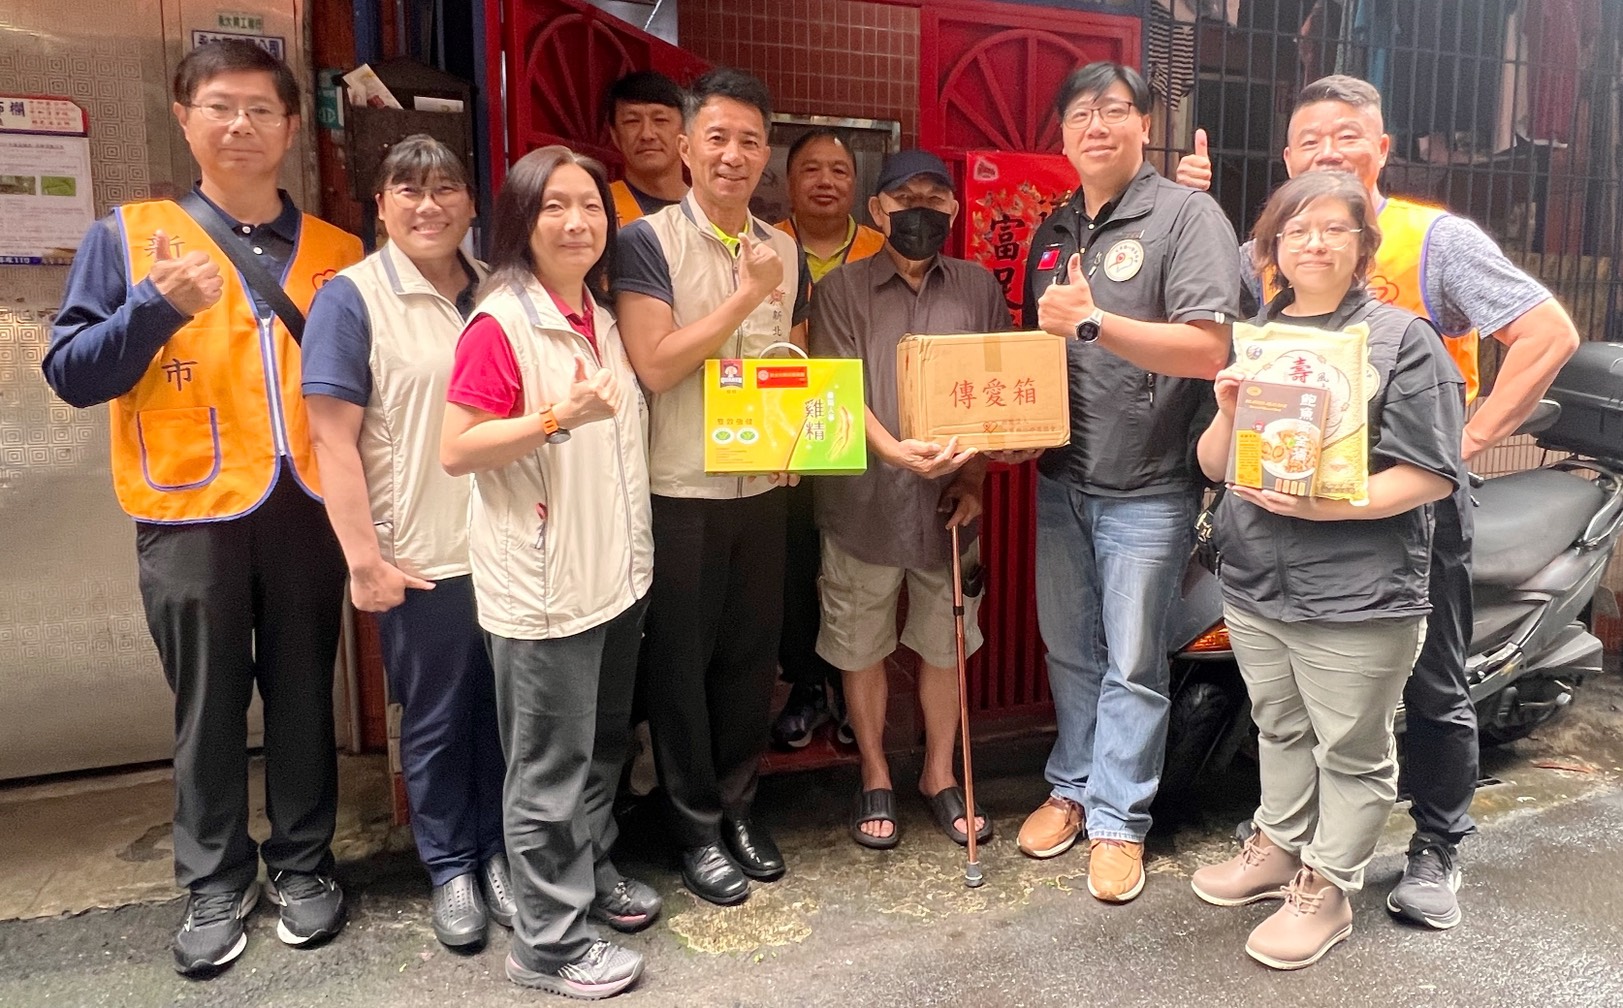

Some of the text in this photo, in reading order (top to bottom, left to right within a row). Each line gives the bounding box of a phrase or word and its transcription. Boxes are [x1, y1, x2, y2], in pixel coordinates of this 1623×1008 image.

[162, 358, 198, 391] 市
[1288, 356, 1314, 384] 壽
[949, 377, 1037, 410] 傳愛箱
[805, 398, 825, 441] 雞精
